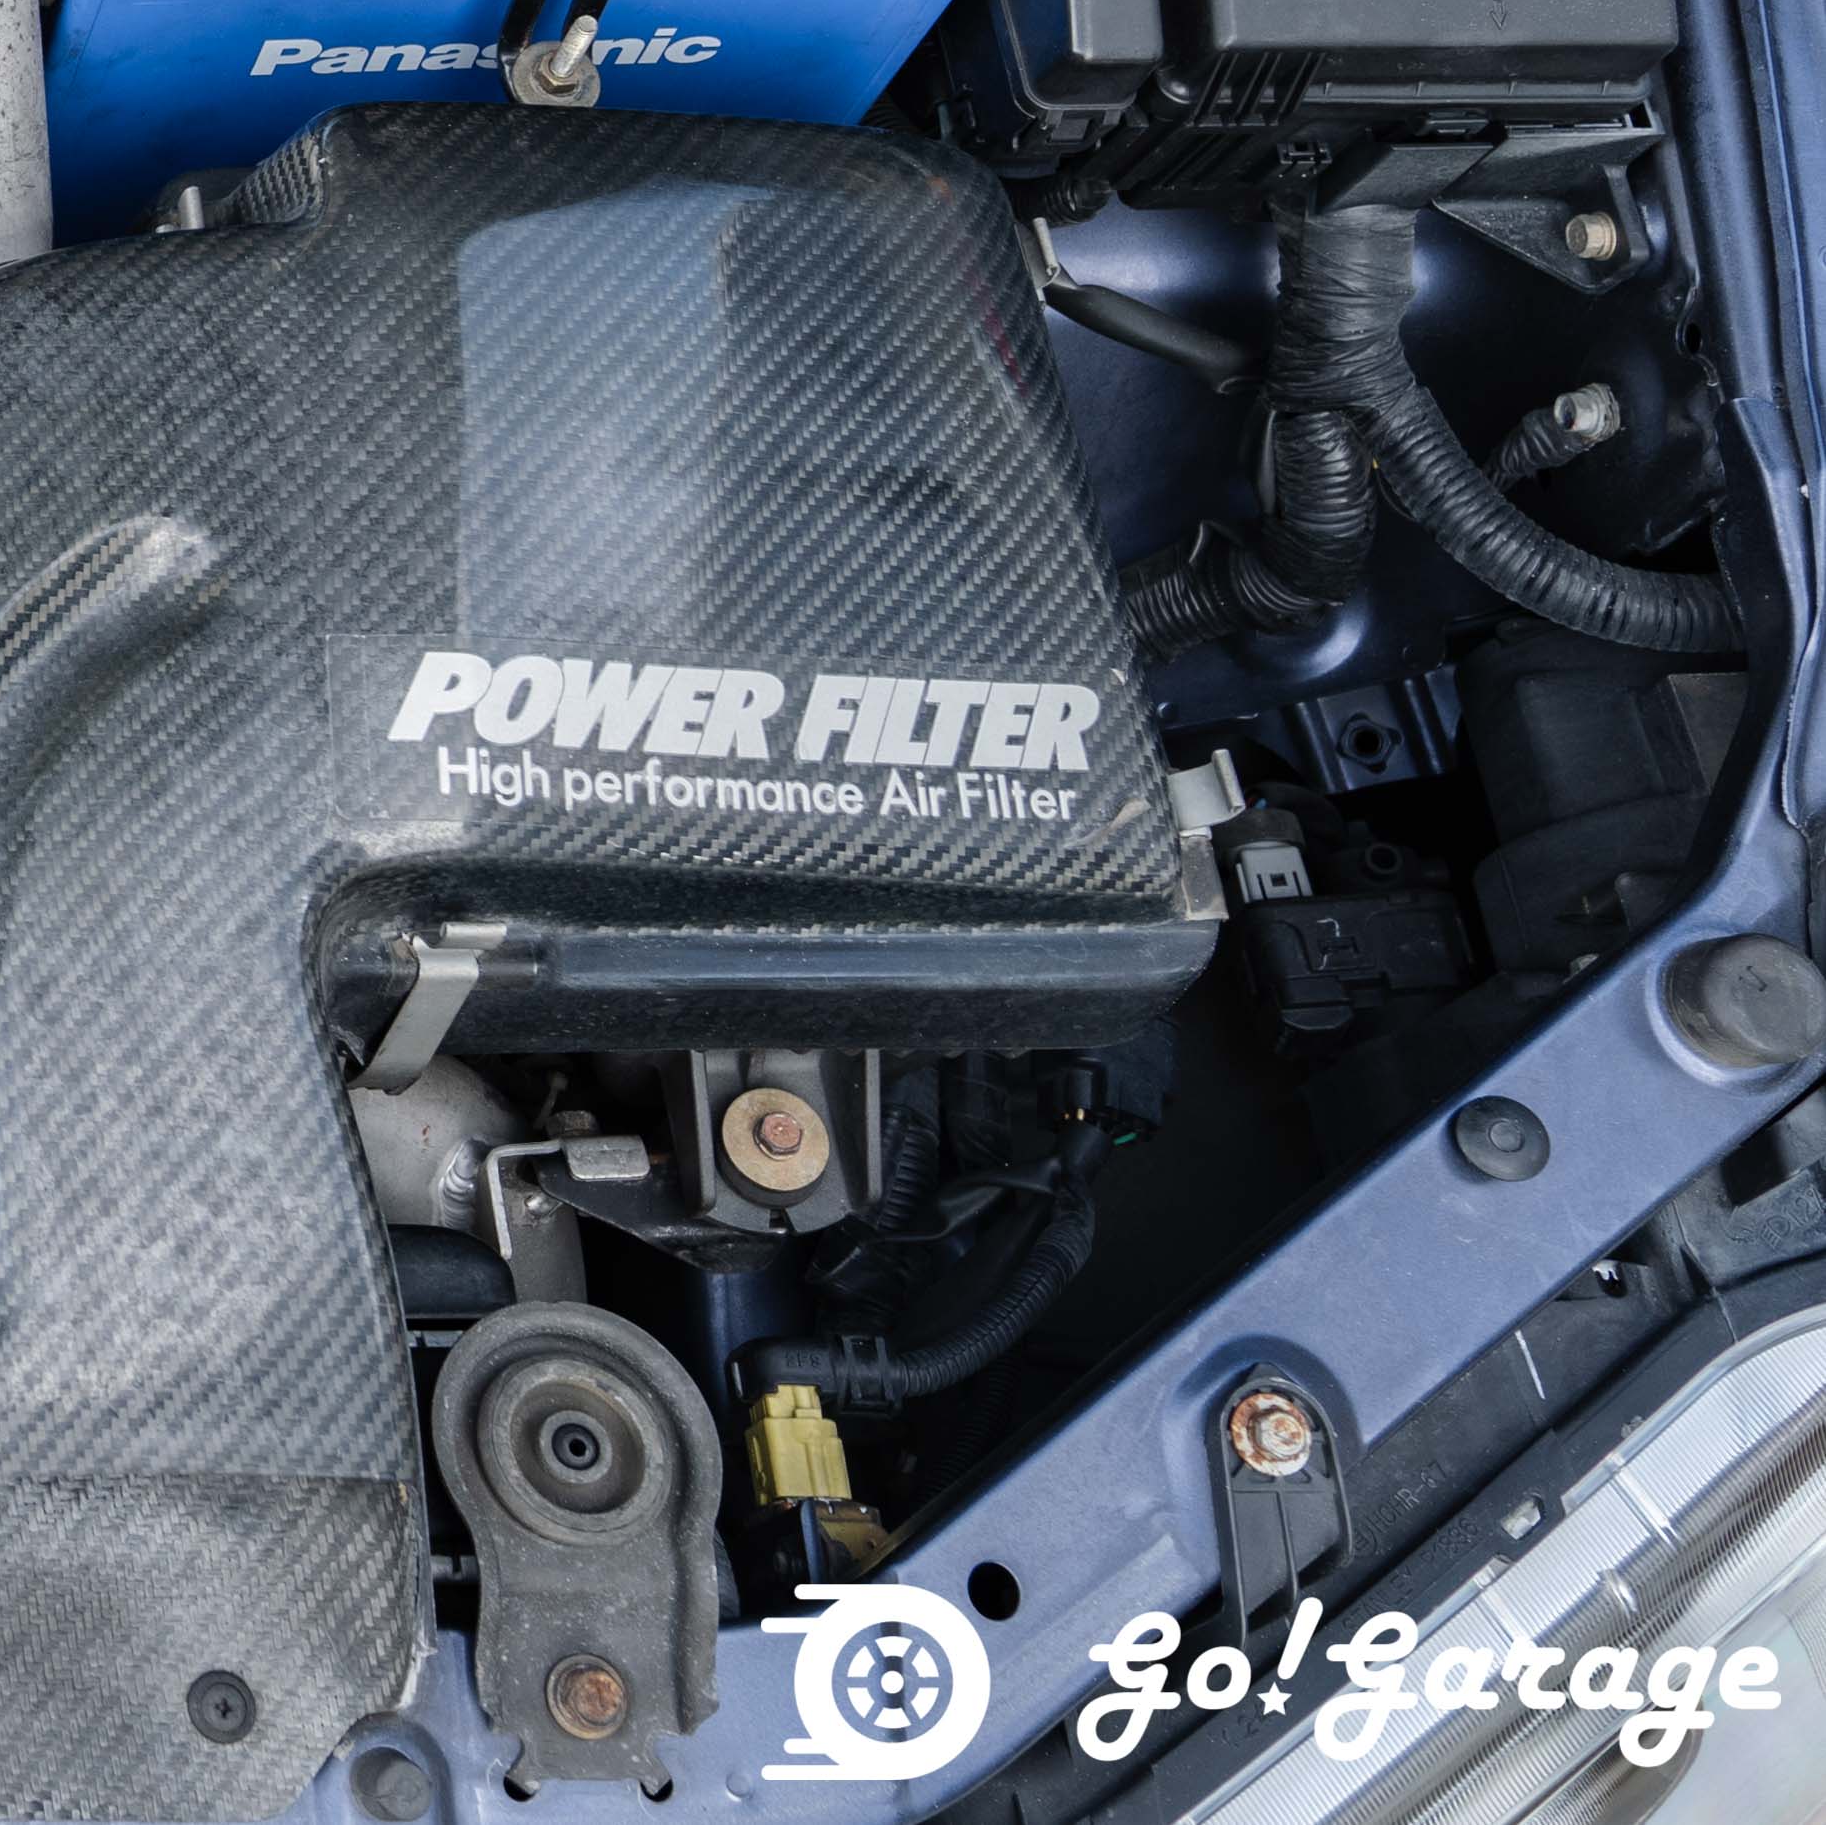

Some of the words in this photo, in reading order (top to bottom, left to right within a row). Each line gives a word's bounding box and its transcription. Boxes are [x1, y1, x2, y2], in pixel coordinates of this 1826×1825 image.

[387, 649, 785, 761] POWER
[795, 674, 1101, 773] FILTER
[436, 746, 551, 809] High
[563, 759, 864, 817] performance
[880, 767, 947, 820] Air
[957, 770, 1077, 823] Filter
